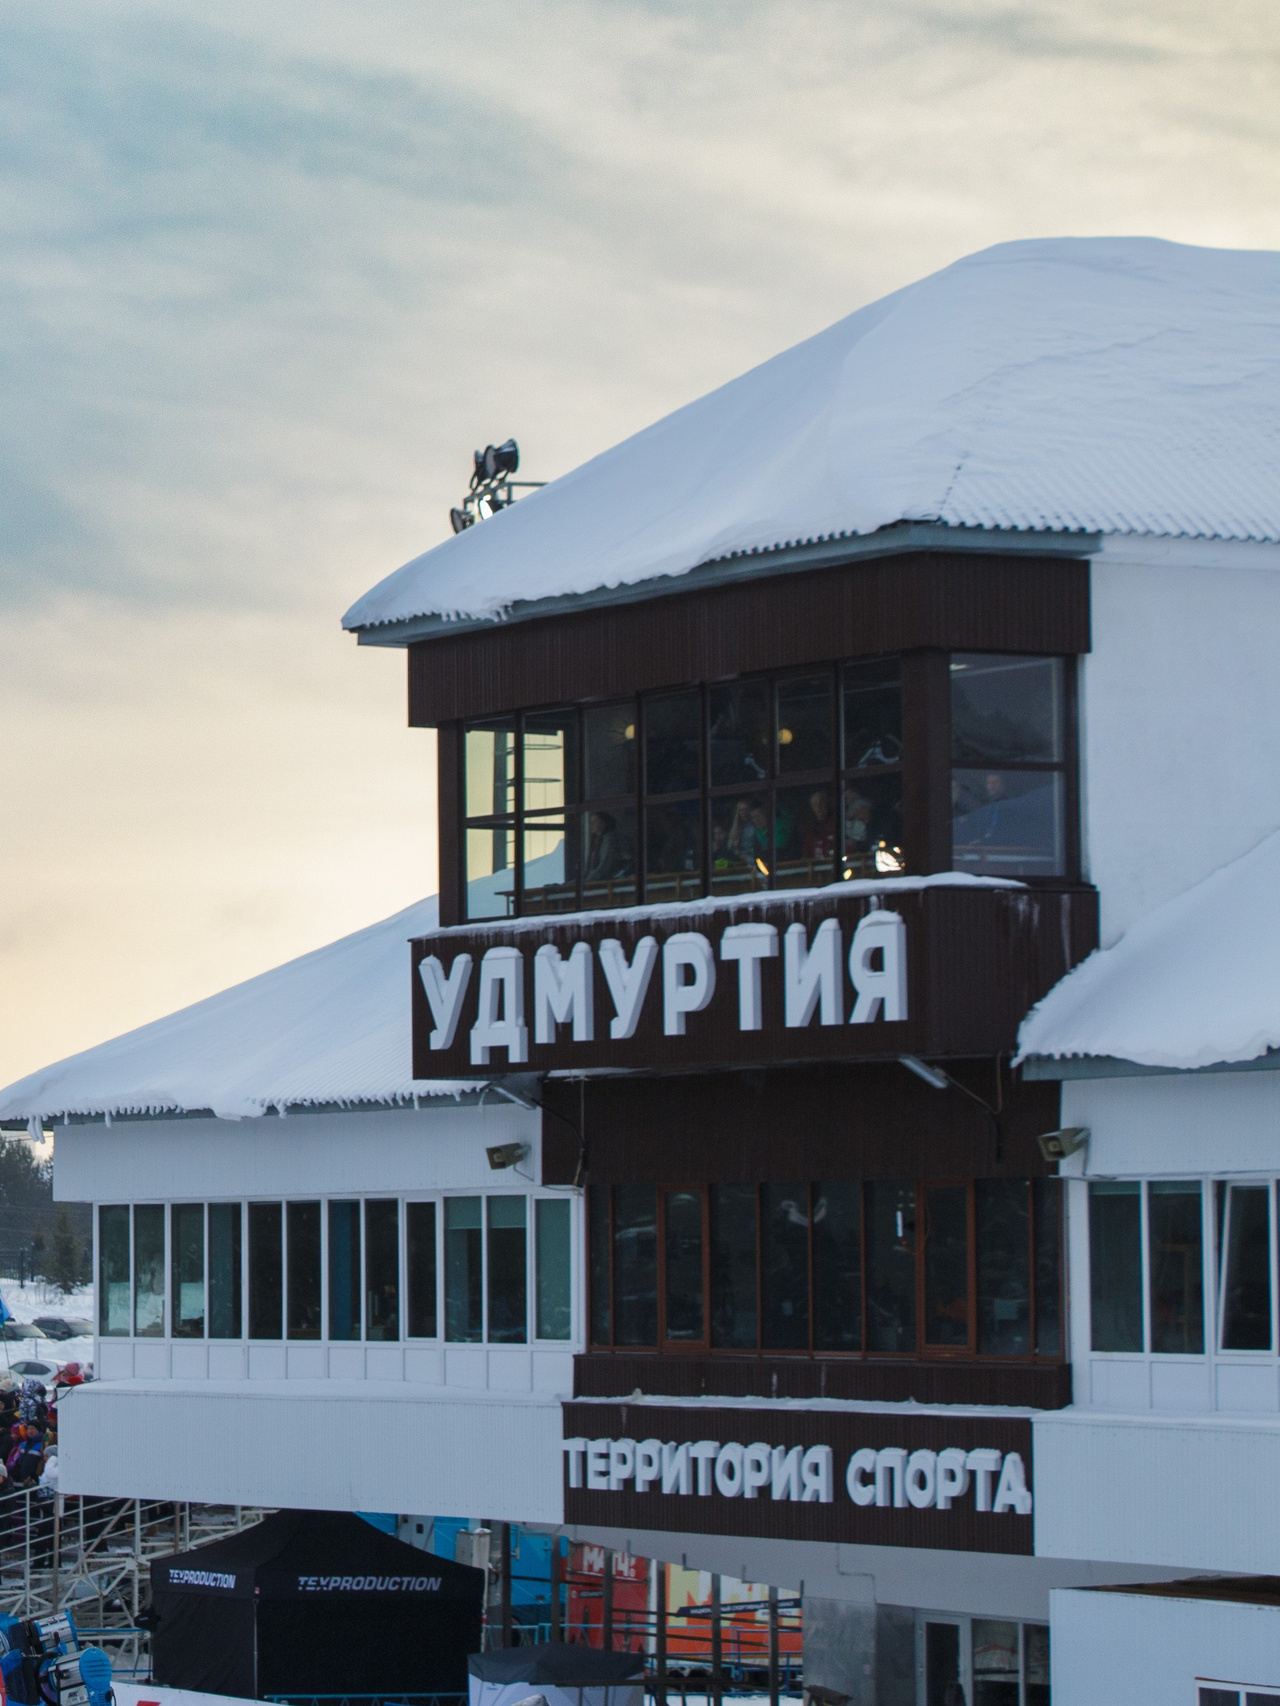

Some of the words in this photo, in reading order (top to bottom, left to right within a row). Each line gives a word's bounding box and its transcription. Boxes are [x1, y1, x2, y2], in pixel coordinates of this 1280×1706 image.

[418, 910, 909, 1067] УДМУРТИЯ
[562, 1437, 834, 1503] ТЕРРИТОРИЯ
[846, 1447, 1033, 1515] СПОРТА
[169, 1569, 237, 1589] TEXPRODUCTION
[298, 1576, 443, 1591] TEXPRODUCTION
